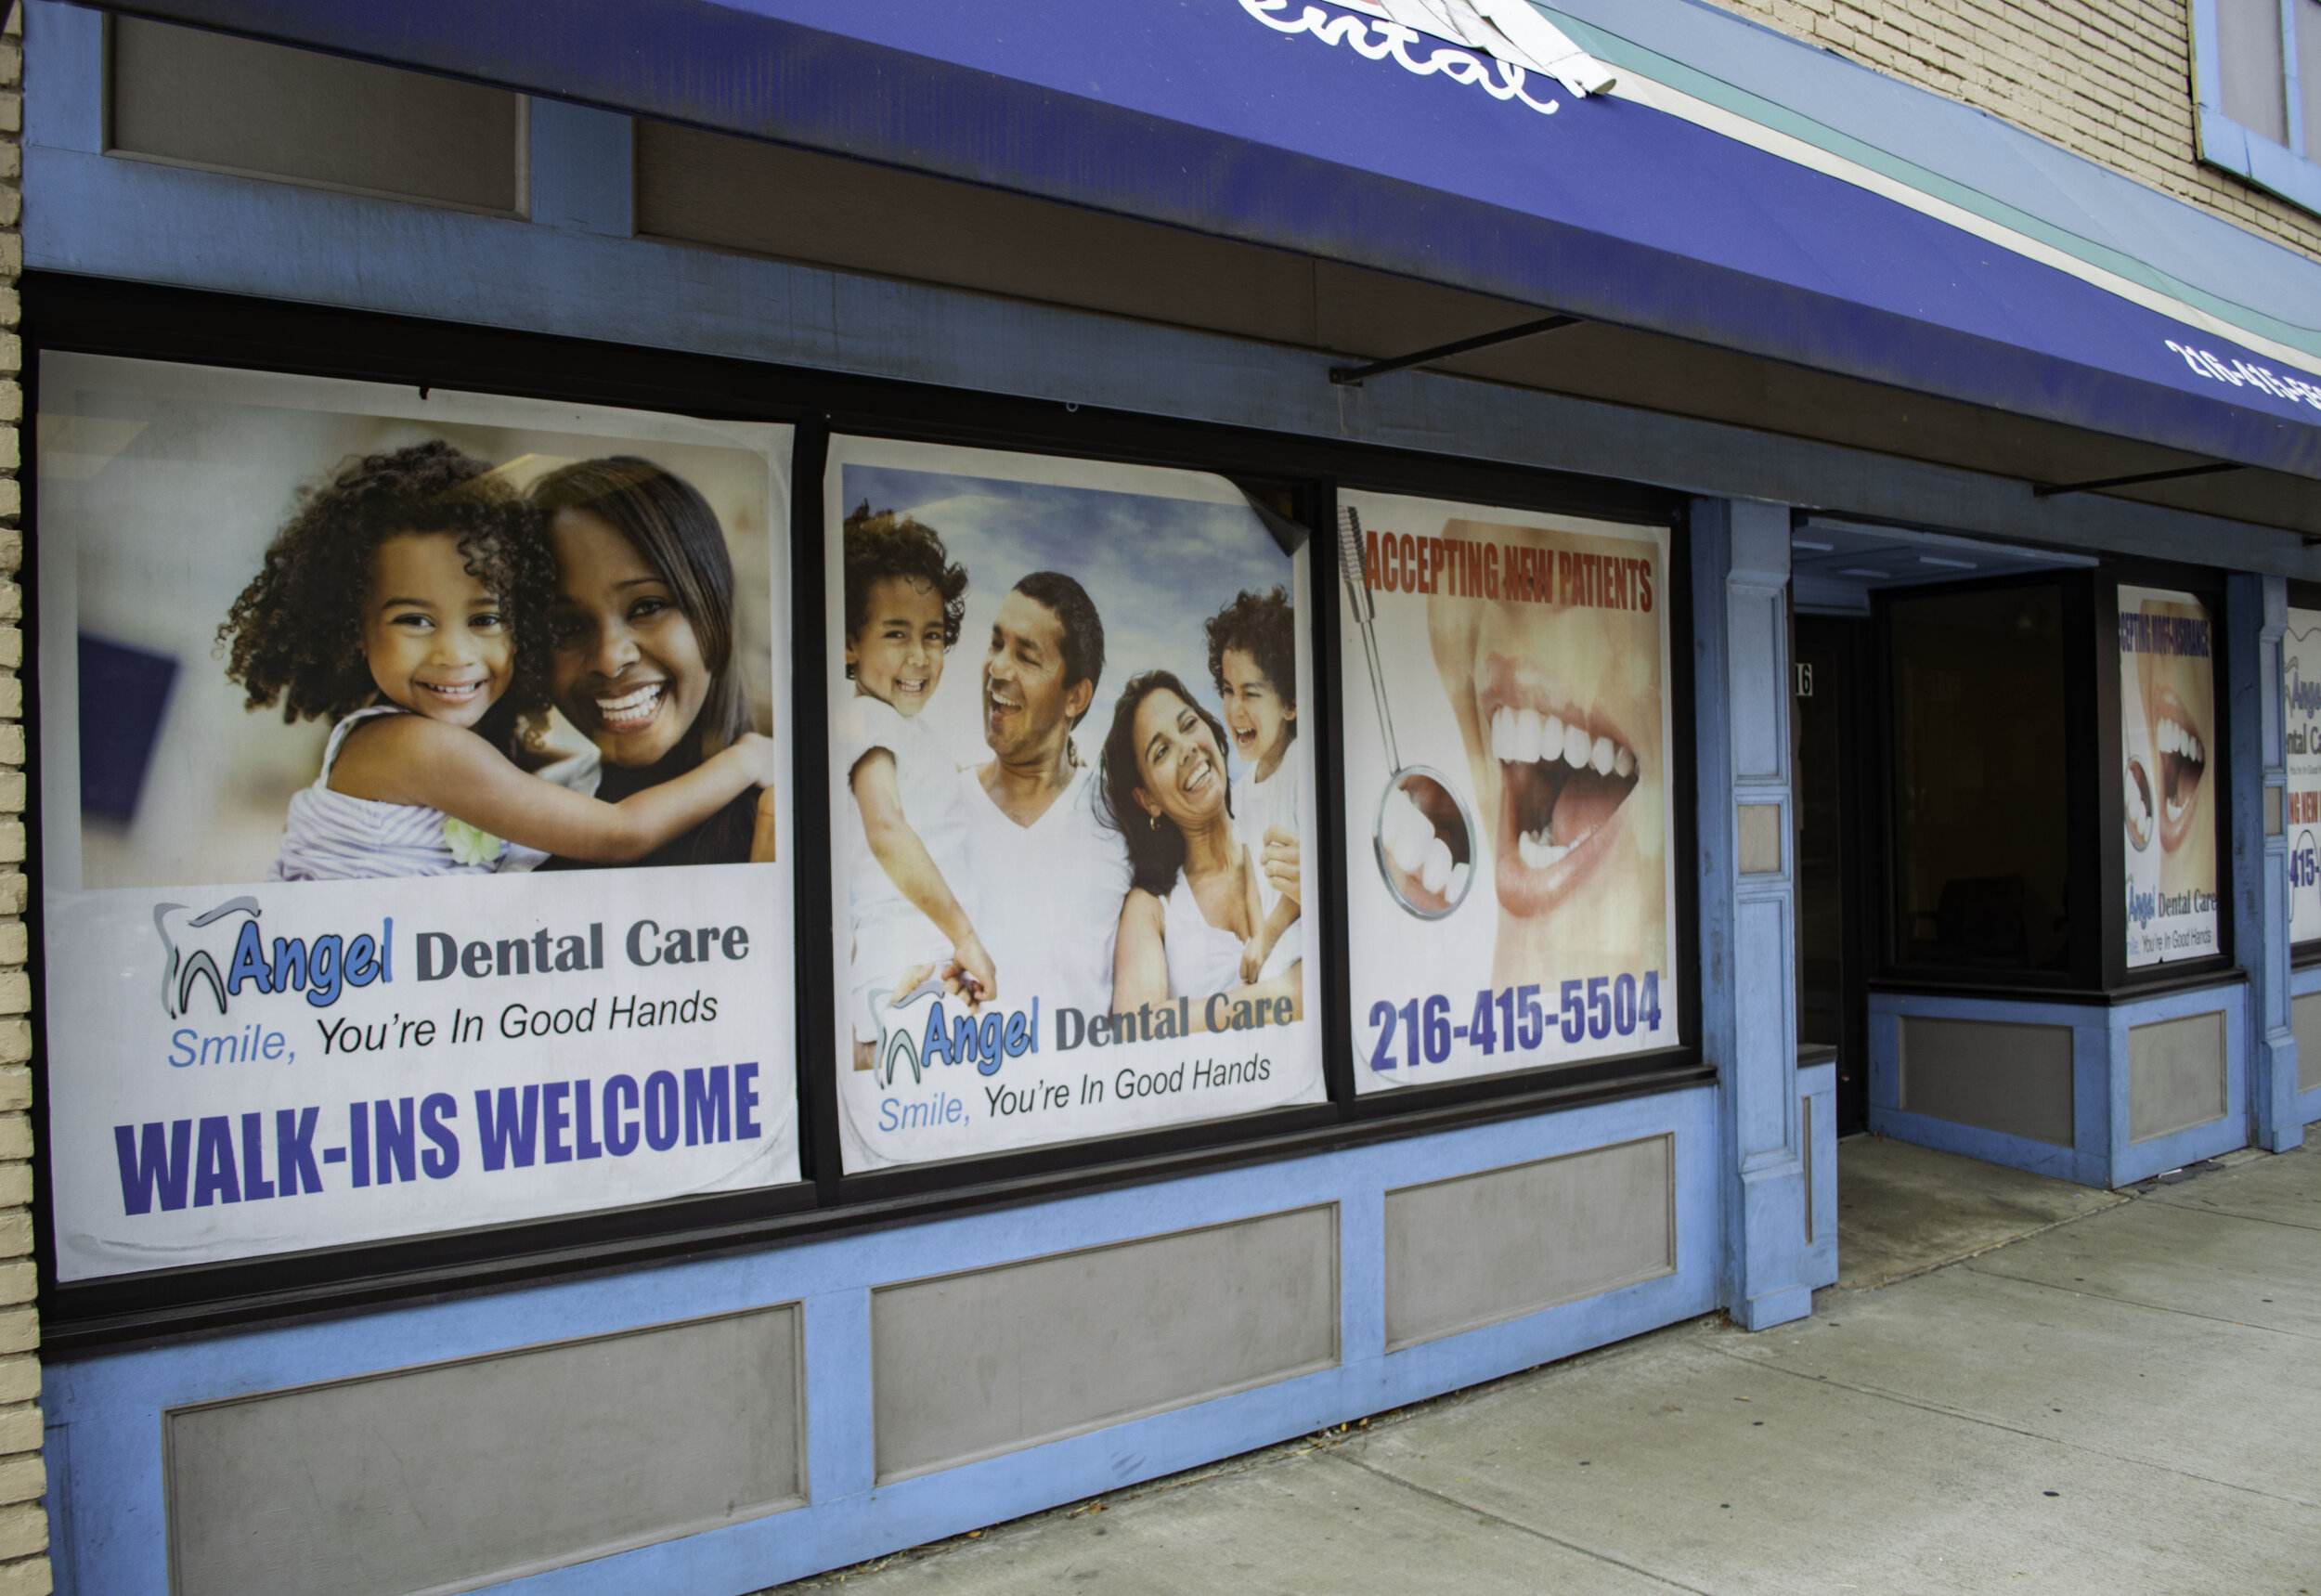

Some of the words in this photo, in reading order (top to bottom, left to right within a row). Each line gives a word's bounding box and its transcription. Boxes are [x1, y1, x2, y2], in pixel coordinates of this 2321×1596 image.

[1365, 531, 1499, 600] ACCEPTING
[1504, 544, 1553, 604] NEW
[1559, 551, 1653, 613] PATIENTS
[2291, 670, 2321, 720] Ange
[2128, 885, 2156, 929] Angel
[2159, 889, 2191, 917] Dental
[2194, 888, 2217, 913] Care
[2172, 929, 2190, 948] Good
[227, 916, 394, 1007] Angel
[416, 922, 604, 982] Dental
[625, 919, 750, 967] Care
[168, 1023, 298, 1067] Smile,
[316, 1012, 436, 1055] You're
[451, 1008, 485, 1045] In
[499, 996, 596, 1039] Good
[608, 990, 720, 1031] Hands
[921, 995, 1039, 1077] Angel
[1056, 995, 1189, 1052] Dental
[1204, 992, 1293, 1034] Care
[1368, 970, 1662, 1071] 216-415-5504
[878, 1091, 970, 1132] Smile,
[984, 1078, 1070, 1118] You're
[1081, 1073, 1105, 1105] In
[1115, 1064, 1183, 1100] Good
[1192, 1053, 1272, 1089] Hands
[114, 1091, 460, 1216] WALK-INS
[475, 1062, 762, 1172] WELCOME
